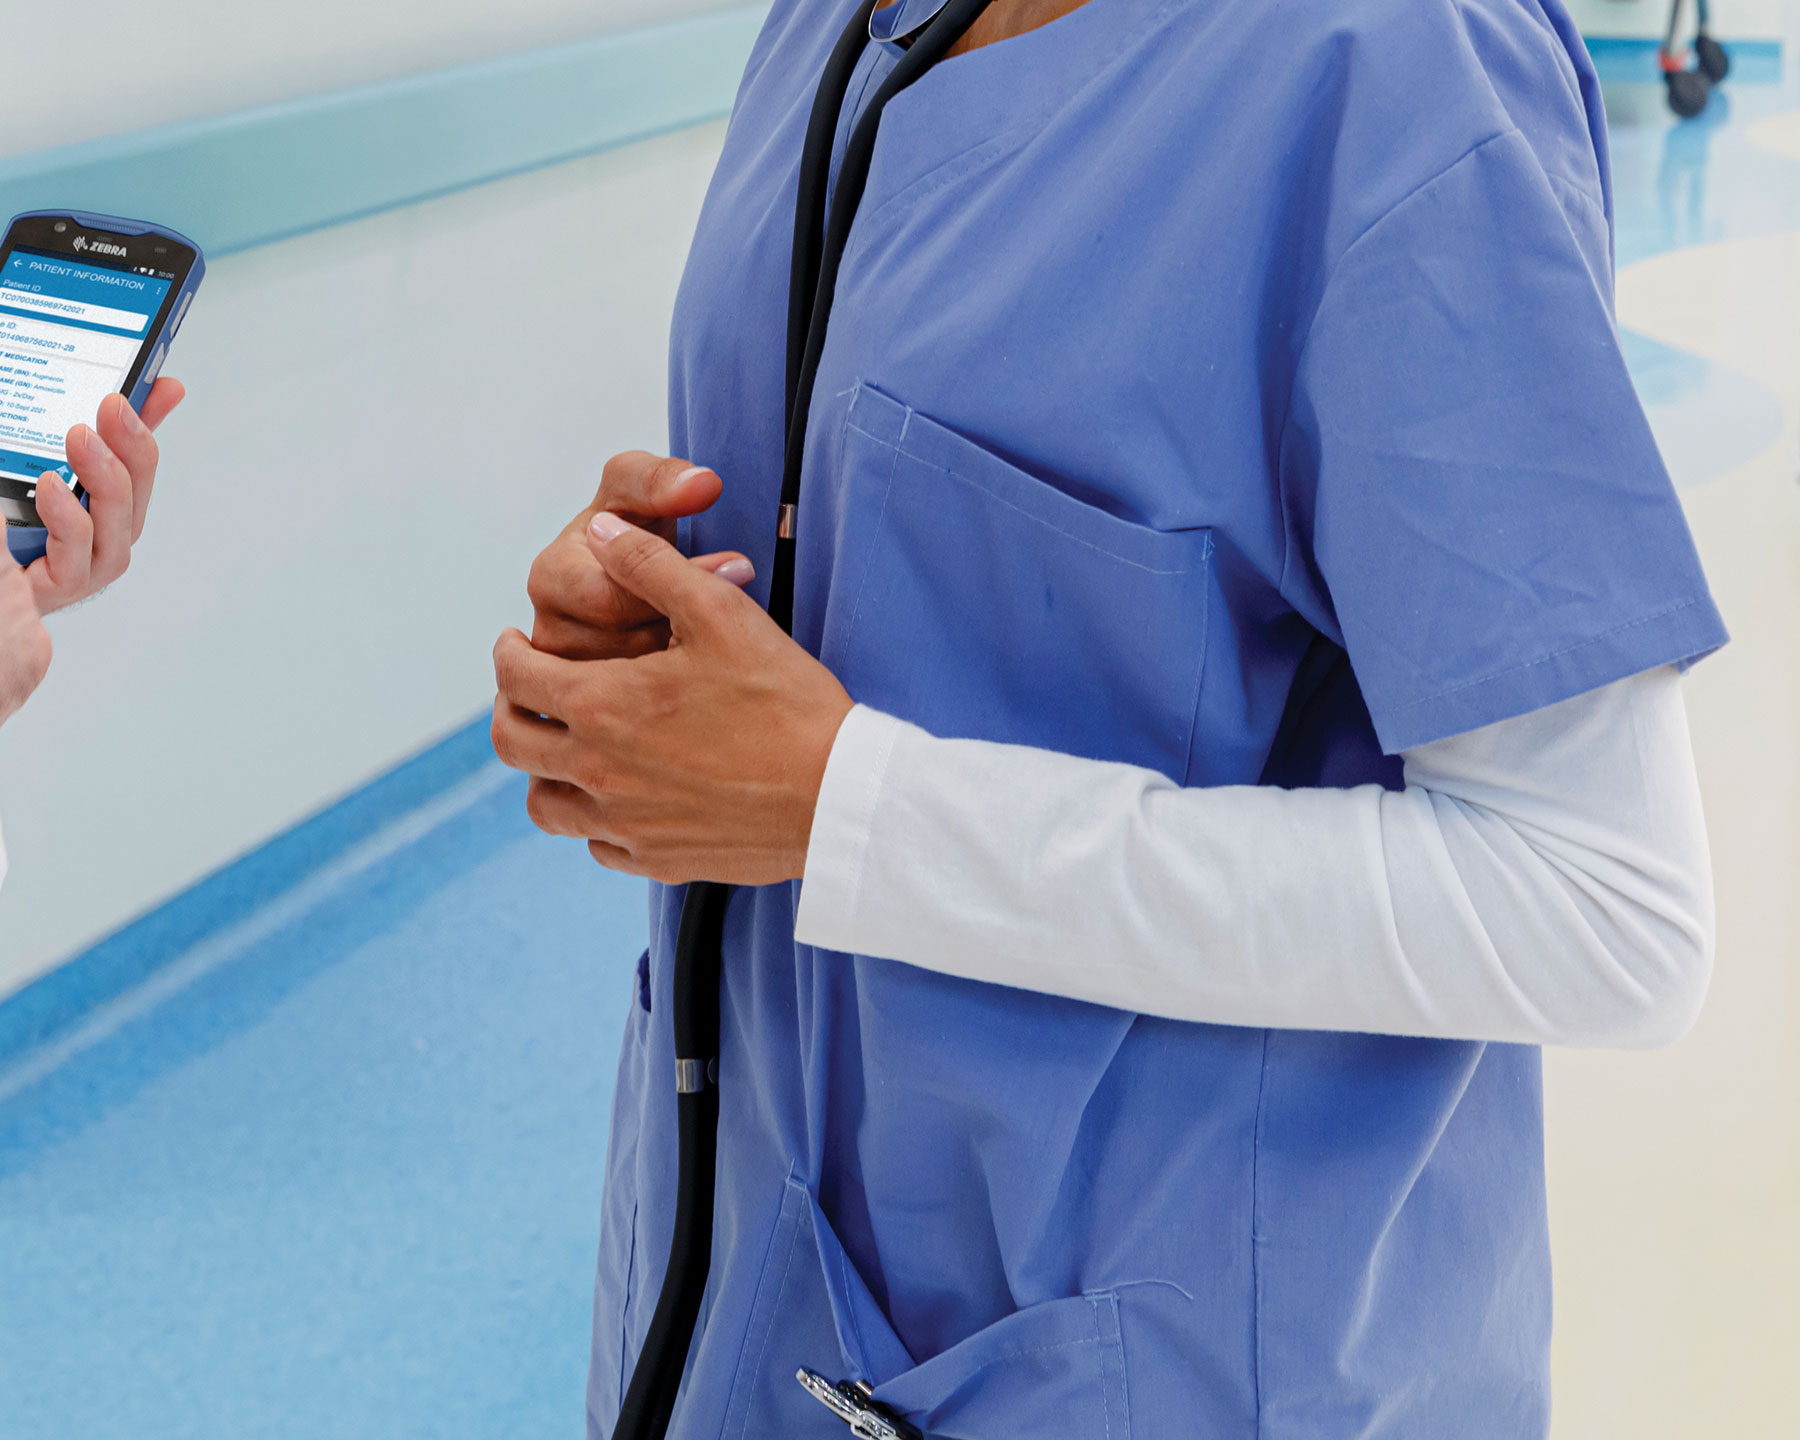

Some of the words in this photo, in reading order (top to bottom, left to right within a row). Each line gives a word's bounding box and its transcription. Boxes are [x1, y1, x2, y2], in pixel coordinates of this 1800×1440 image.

[89, 241, 127, 257] ZEBRA
[29, 261, 71, 277] PATIENT
[72, 269, 145, 290] INFORMATION
[158, 270, 175, 280] 10:00
[3, 278, 30, 291] Patient
[31, 283, 41, 292] ID
[4, 351, 48, 366] MEDICATION
[31, 406, 47, 414] 2021
[25, 462, 48, 472] Menu
